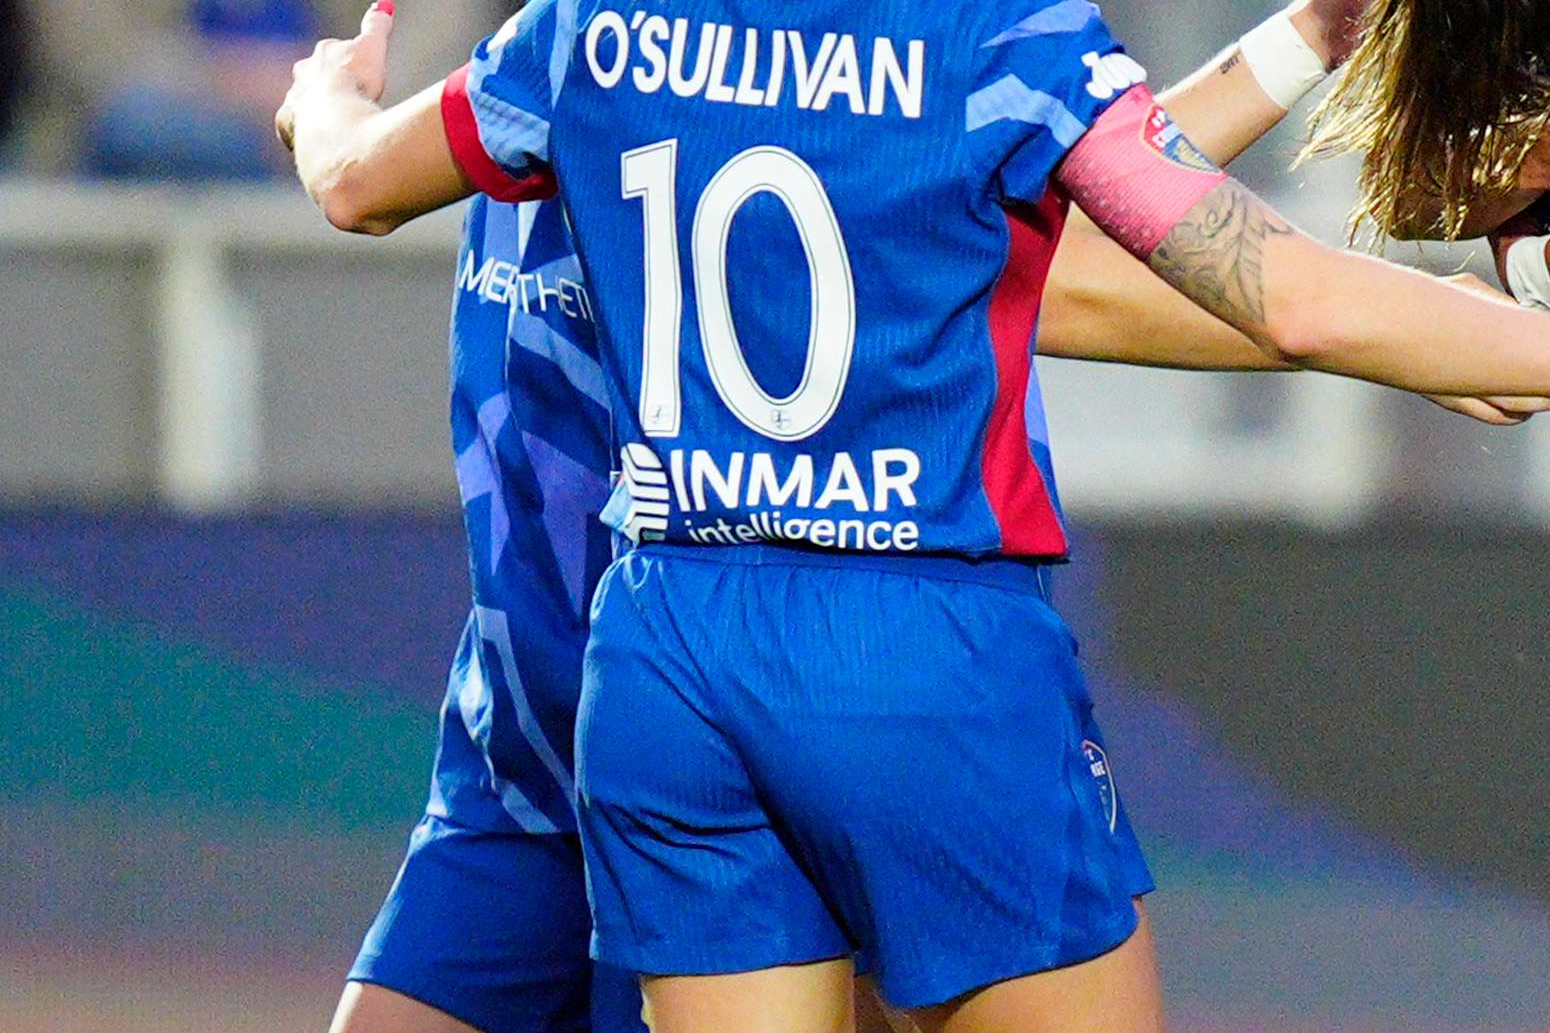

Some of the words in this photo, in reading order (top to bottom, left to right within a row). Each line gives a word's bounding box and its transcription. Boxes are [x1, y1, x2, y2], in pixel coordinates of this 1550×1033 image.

[585, 10, 925, 119] O'SULLIVAN
[621, 138, 856, 442] 10
[670, 448, 921, 512] INMAR
[684, 511, 920, 551] intelligence
